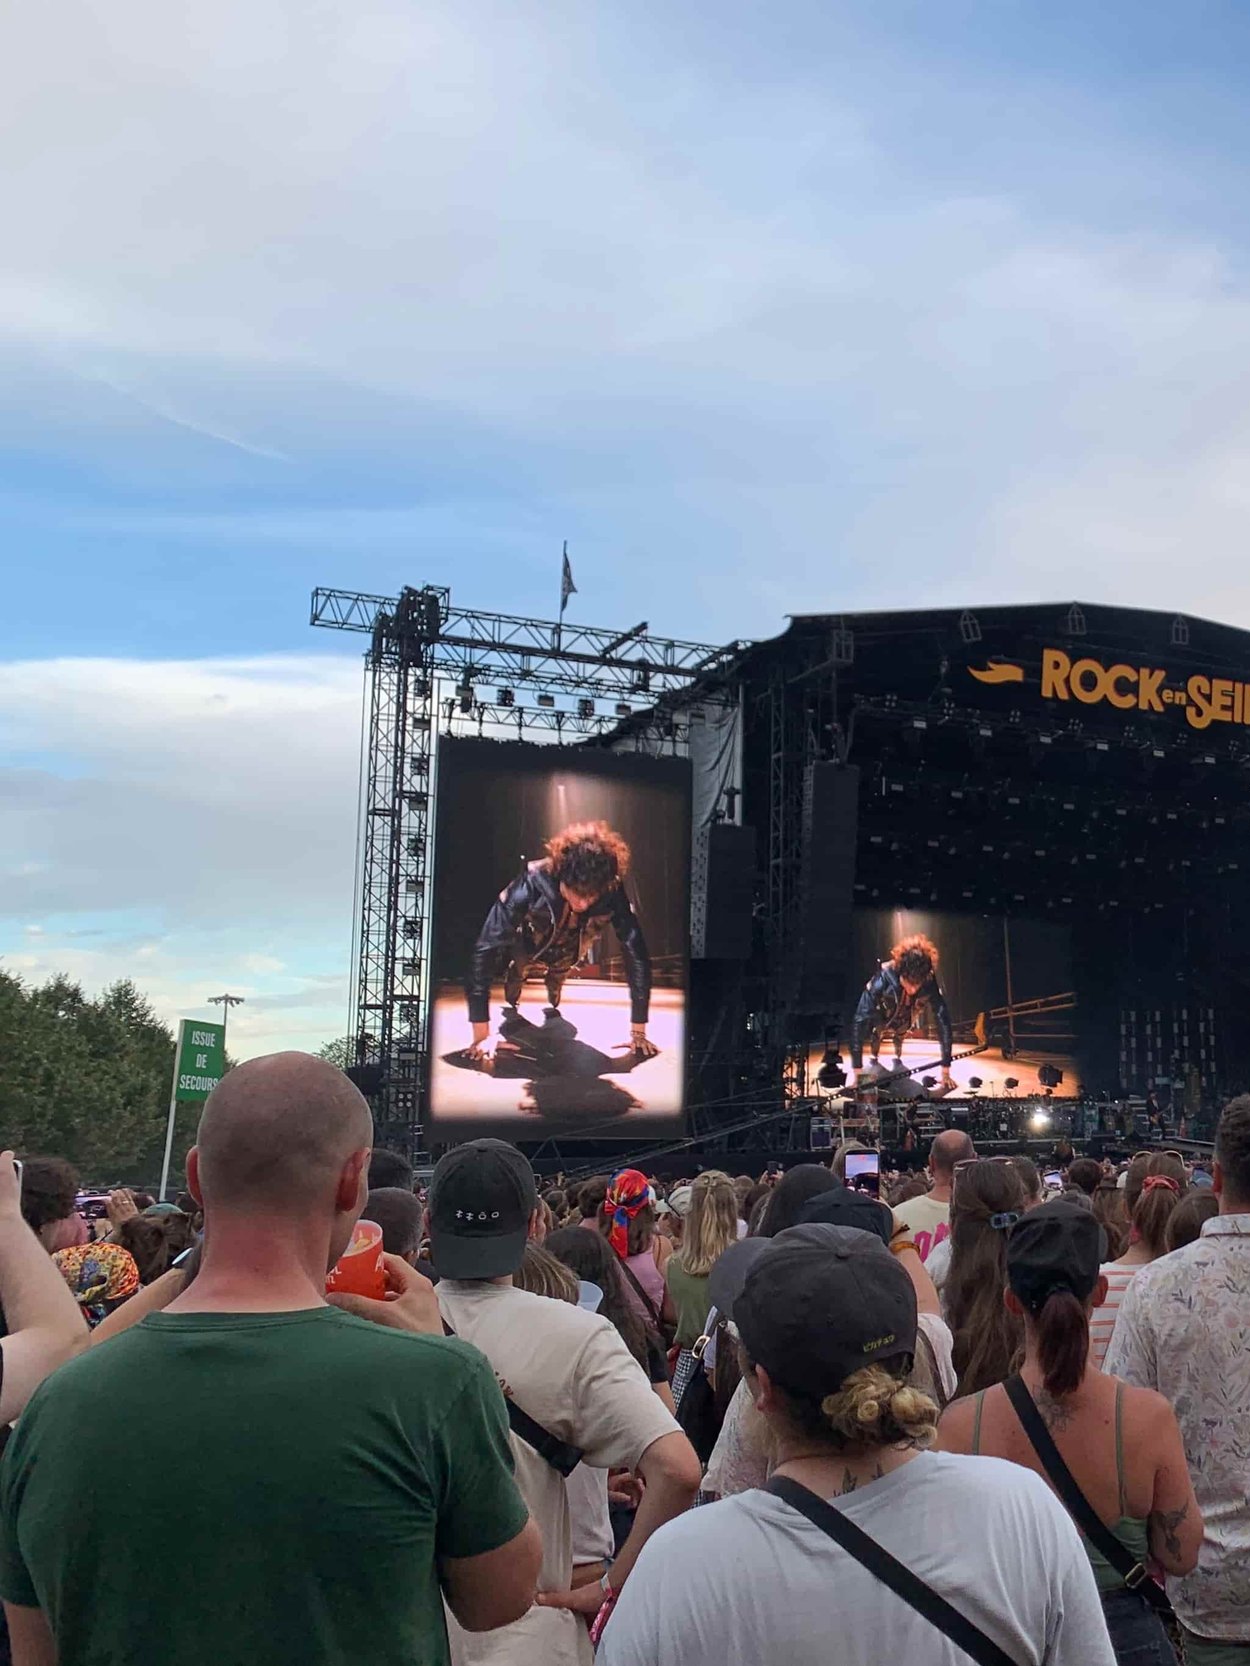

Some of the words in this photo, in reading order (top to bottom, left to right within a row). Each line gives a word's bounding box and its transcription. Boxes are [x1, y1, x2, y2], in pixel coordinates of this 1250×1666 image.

[1041, 649, 1165, 712] ROCK
[1162, 689, 1187, 705] en
[191, 1031, 216, 1047] ISSUE
[195, 1053, 208, 1068] DE
[179, 1074, 219, 1092] SECOURS
